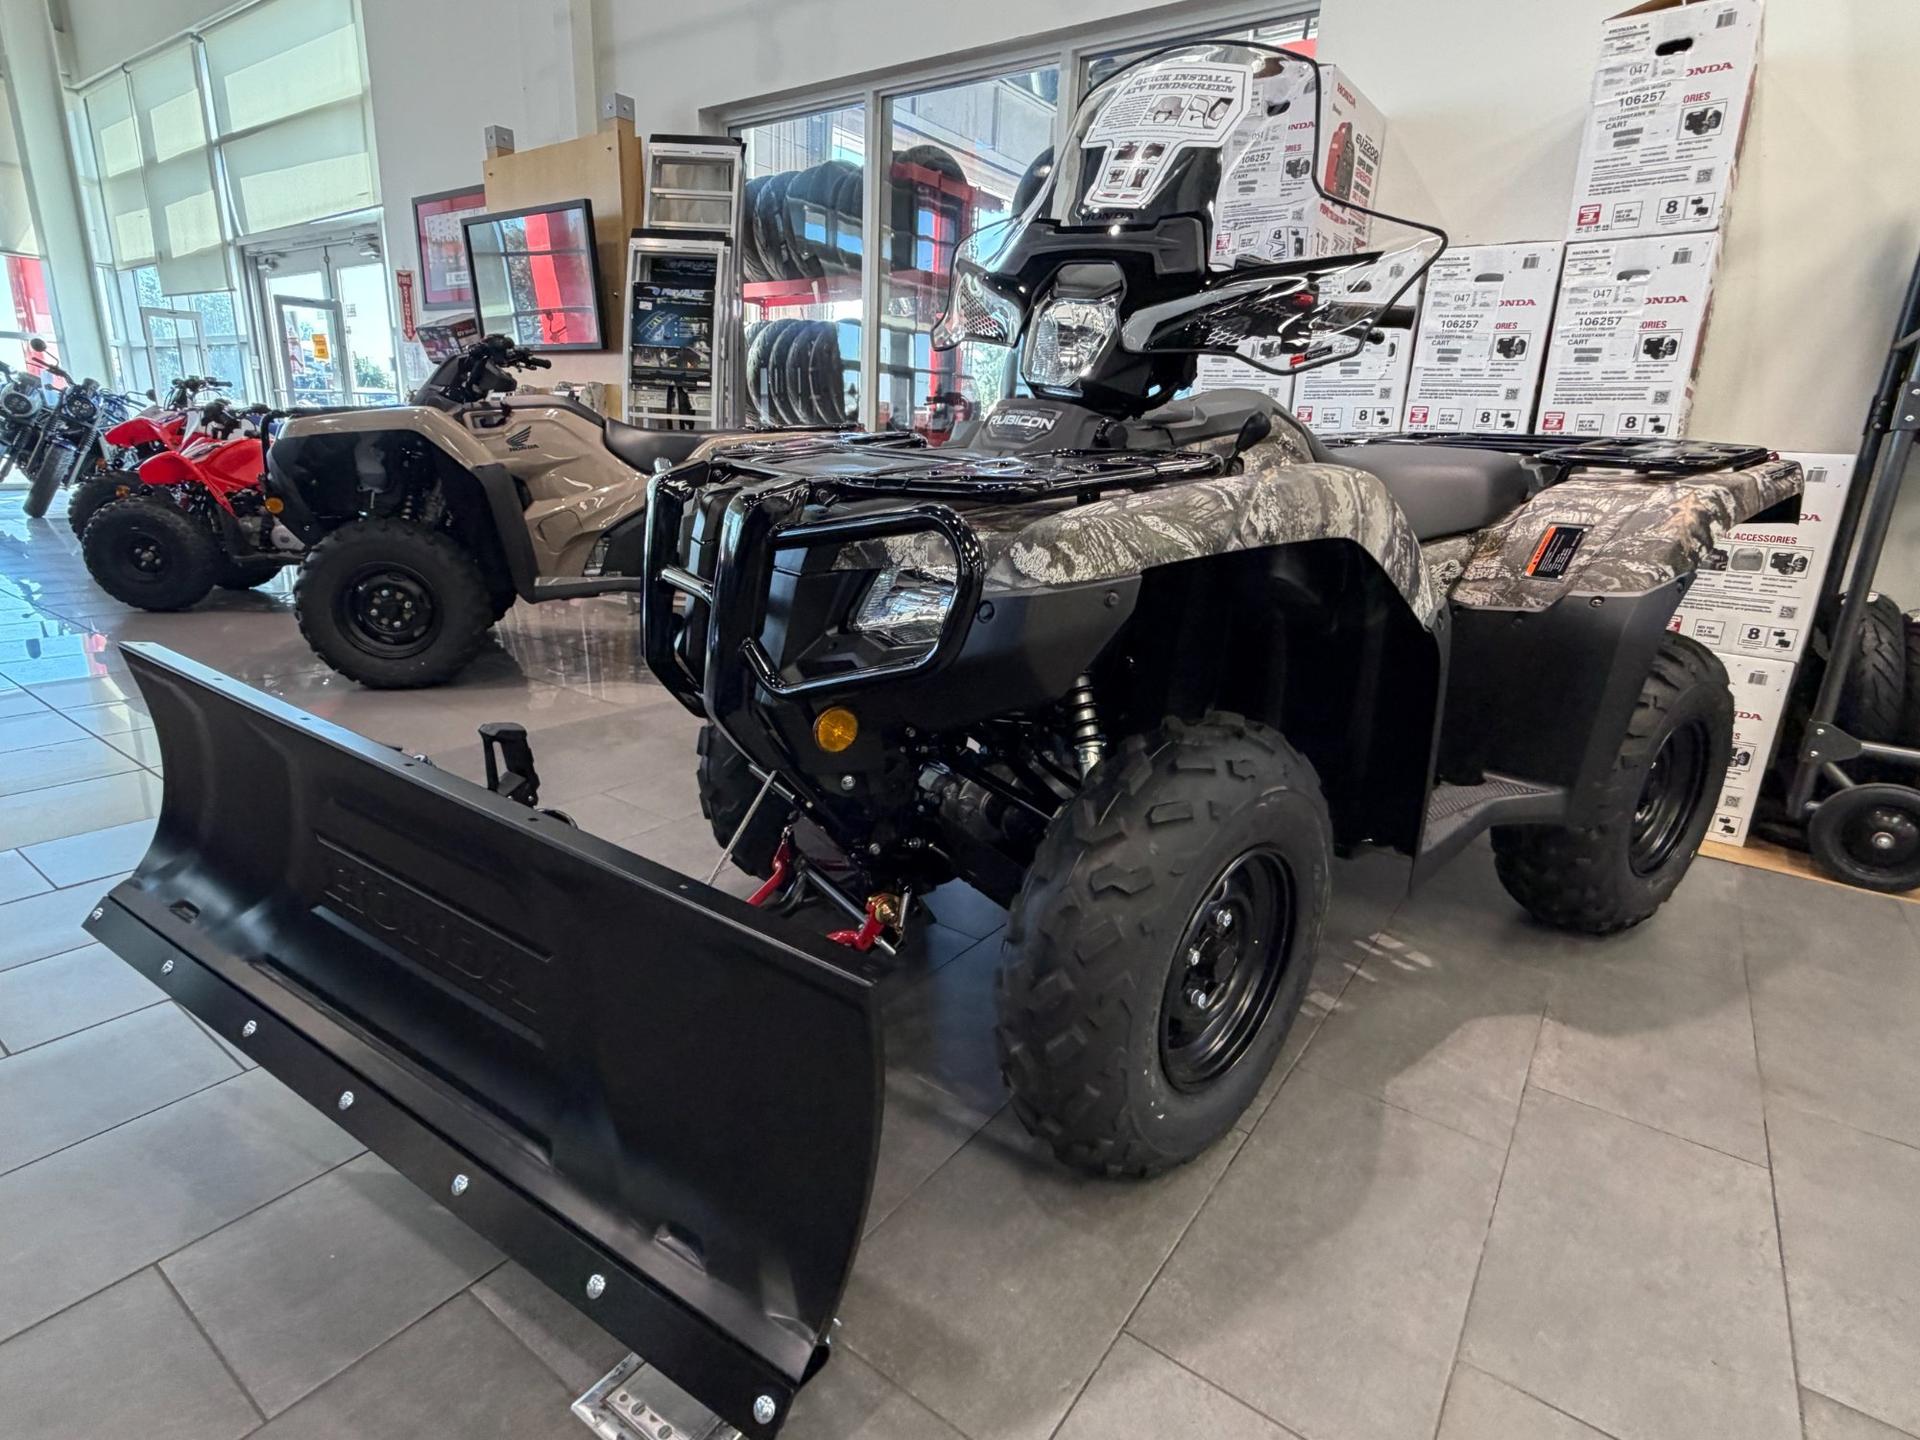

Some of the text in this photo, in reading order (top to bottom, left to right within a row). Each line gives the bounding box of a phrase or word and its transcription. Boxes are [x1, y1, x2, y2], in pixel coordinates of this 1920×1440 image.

[1135, 73, 1233, 86] QUICK INSTALL
[1124, 82, 1236, 95] ATV WINDSCREEN
[1337, 82, 1356, 109] HONDA
[1619, 90, 1666, 108] 106257
[1605, 121, 1628, 130] CART
[1241, 153, 1271, 164] 106257
[1666, 200, 1678, 214] 8
[1273, 230, 1282, 239] 8
[1453, 294, 1470, 303] 047
[1441, 320, 1479, 329] 106257
[1579, 316, 1622, 326] 106257
[1359, 409, 1368, 421] 8
[1480, 411, 1491, 423] 8
[988, 415, 1055, 430] RUBICON
[1624, 416, 1637, 429] 8
[509, 444, 540, 452] HONDA
[1734, 532, 1798, 545] ACCESSORIES
[1747, 627, 1760, 640] 8
